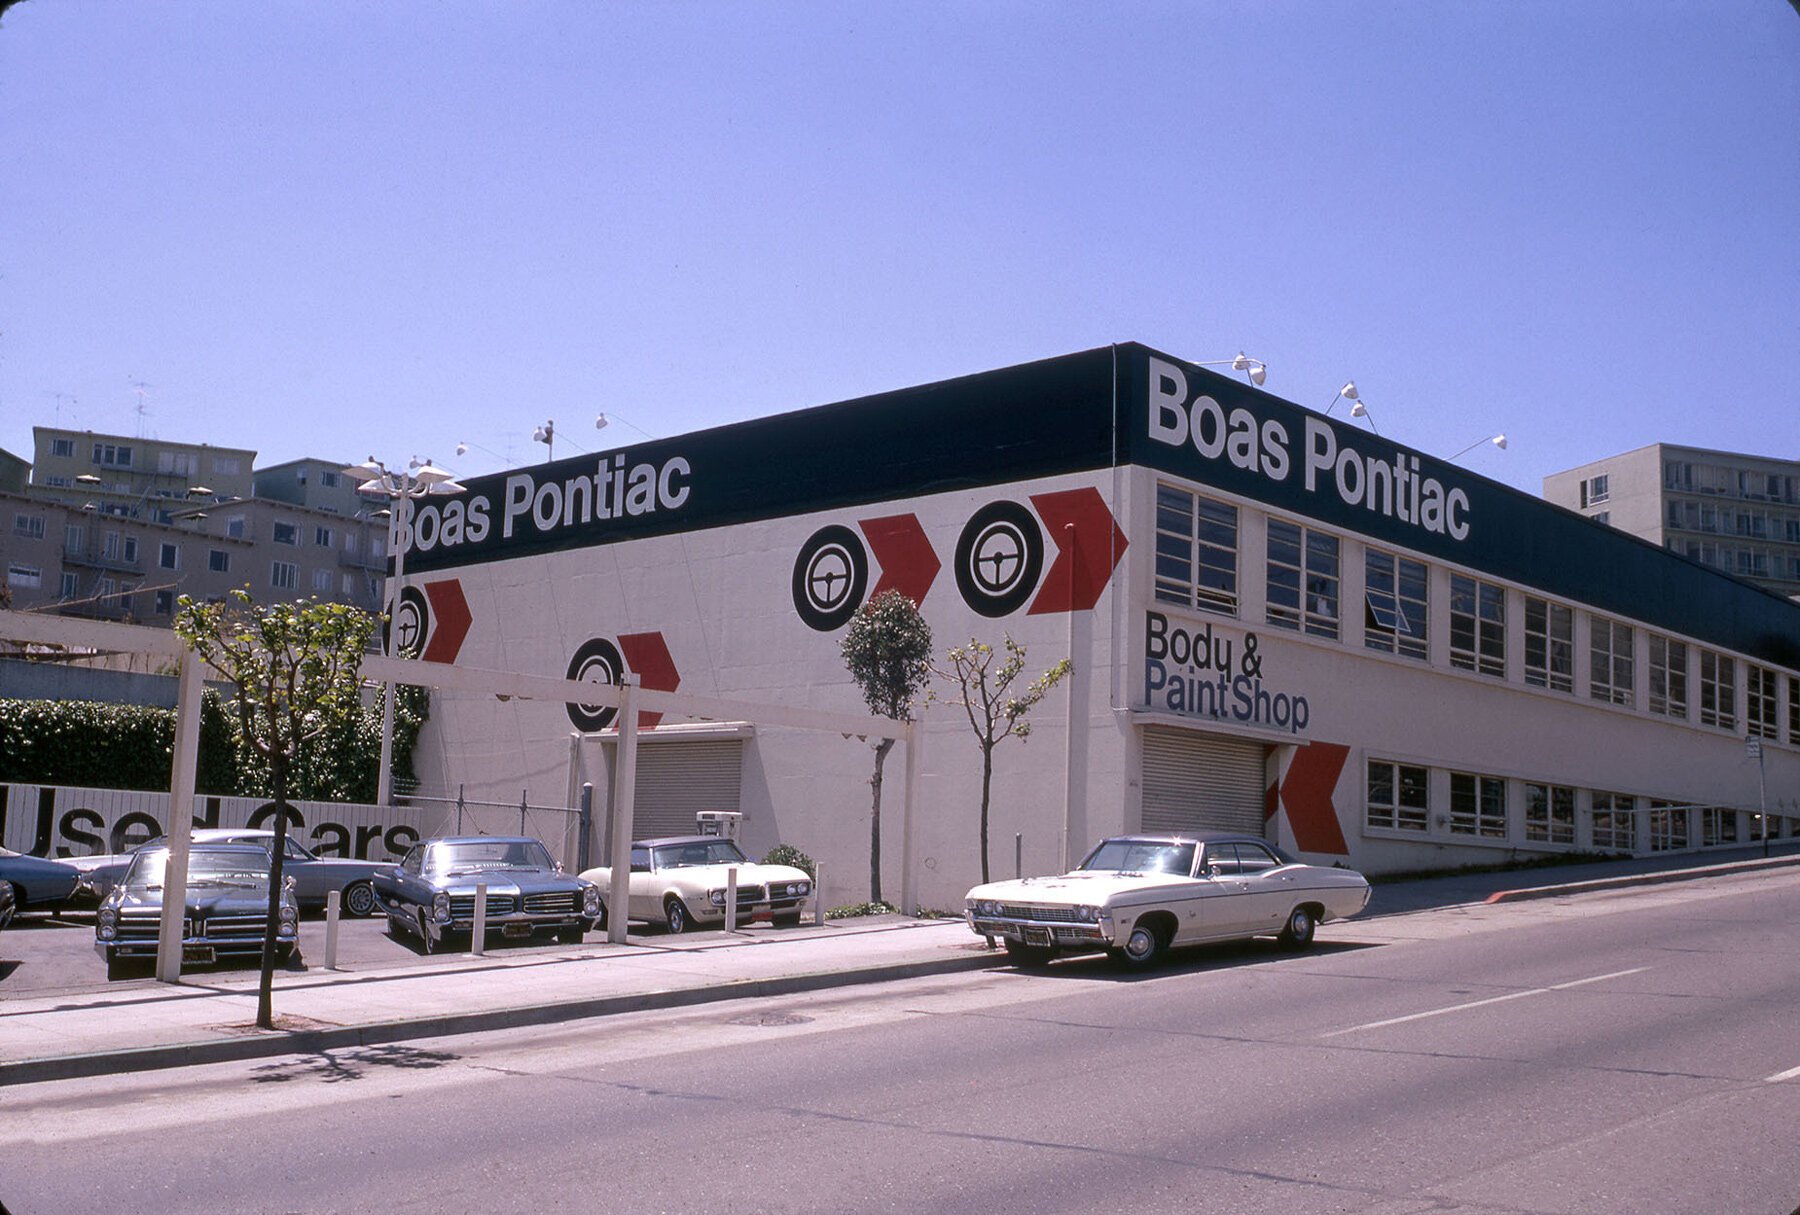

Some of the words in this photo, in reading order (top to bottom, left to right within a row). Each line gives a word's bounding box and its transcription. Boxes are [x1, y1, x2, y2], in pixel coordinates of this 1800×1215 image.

[1148, 356, 1290, 481] Boas
[1305, 415, 1471, 541] Pontiac
[387, 496, 491, 557] Boas
[503, 453, 692, 538] Pontiac
[1146, 610, 1232, 683] Body
[1241, 632, 1263, 679] &
